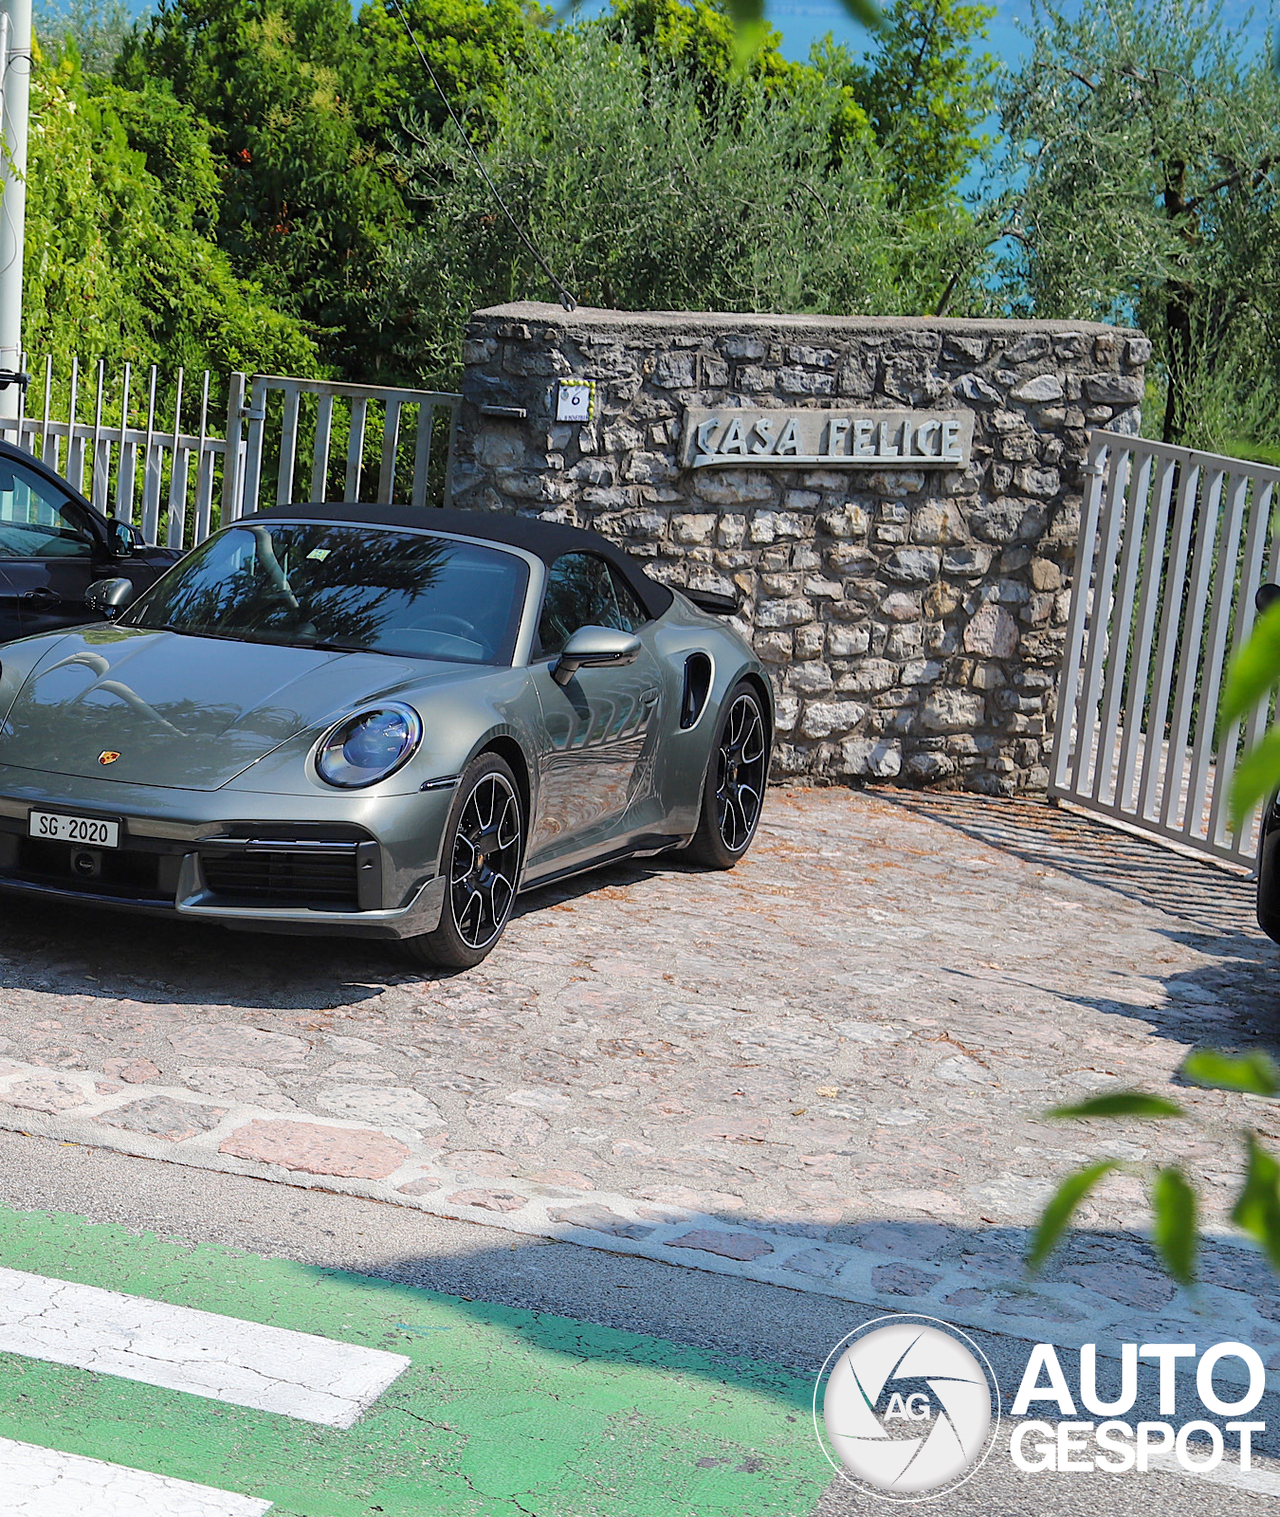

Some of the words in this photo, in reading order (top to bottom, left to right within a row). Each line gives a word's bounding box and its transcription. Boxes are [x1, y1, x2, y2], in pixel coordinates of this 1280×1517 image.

[571, 390, 582, 406] 6
[696, 417, 804, 455] CASA
[827, 418, 964, 457] FELICE
[68, 819, 108, 843] 2020
